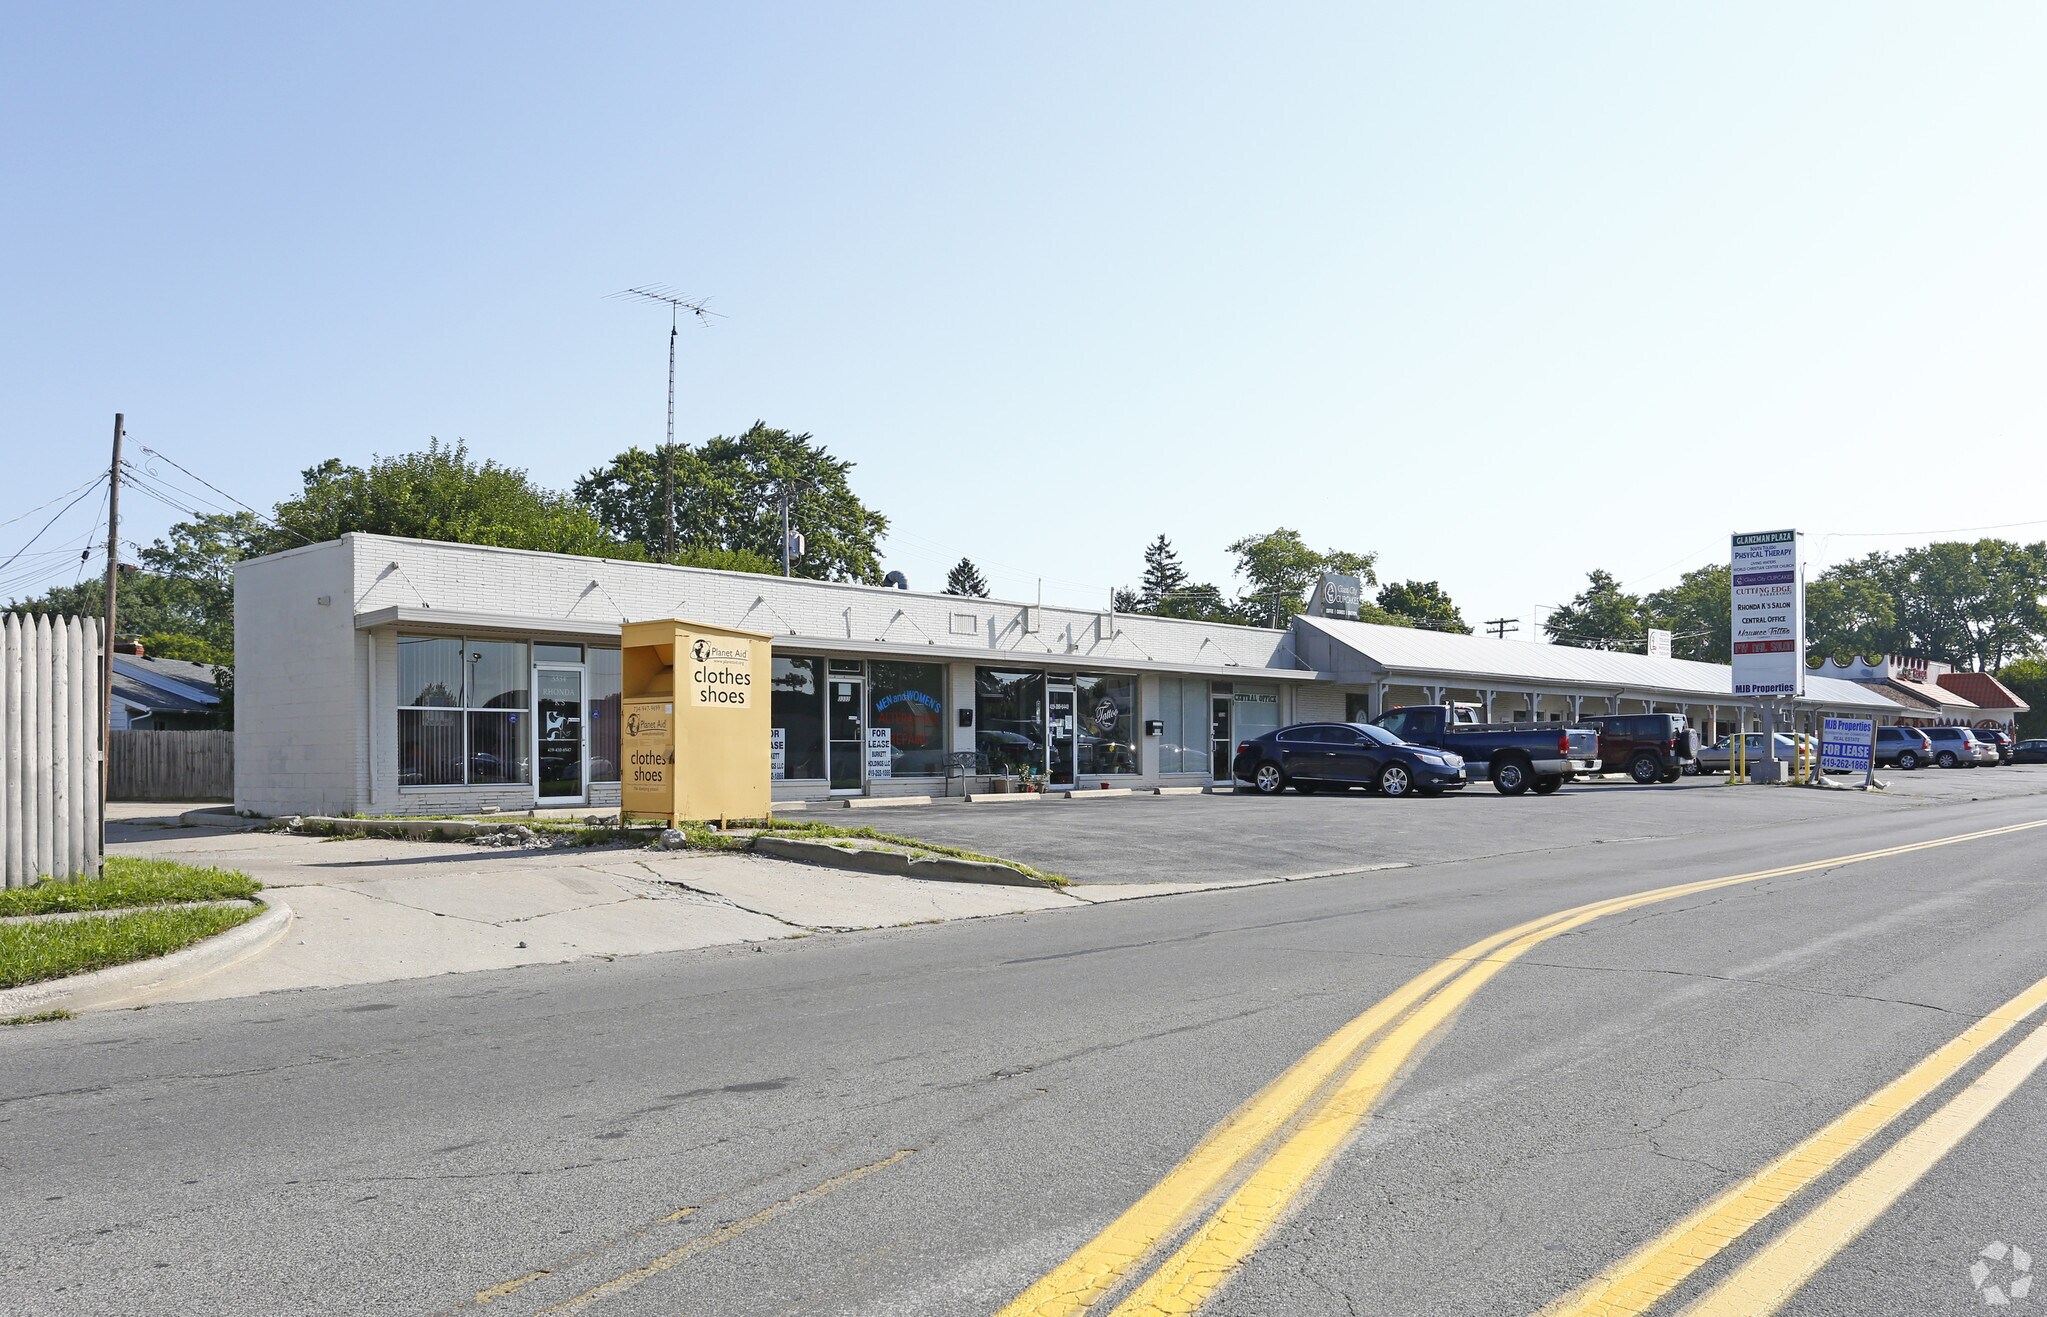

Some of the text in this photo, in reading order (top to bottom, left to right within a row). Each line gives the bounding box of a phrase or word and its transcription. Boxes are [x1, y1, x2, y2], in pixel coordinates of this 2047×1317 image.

[1736, 532, 1792, 545] GLANZMAN PLAZA
[1764, 548, 1792, 557] THERAPY
[1736, 587, 1770, 595] CUTTING
[1738, 603, 1760, 611] RHONDA
[711, 647, 747, 658] Planet Aid
[694, 666, 751, 686] clothes
[543, 688, 575, 696] RHONDA
[1735, 683, 1794, 693] MJB Properties
[700, 685, 745, 704] shoes
[1234, 694, 1277, 703] CENTRAL OFFICE
[875, 694, 893, 713] MEN
[893, 693, 907, 703] and
[640, 720, 667, 729] Planet Aid
[1825, 719, 1872, 732] MJB Properties
[872, 729, 886, 738] FOR
[868, 740, 890, 748] LEASE
[1823, 743, 1869, 758] FOR LEASE
[631, 750, 667, 765] clothes
[1822, 758, 1868, 770] 419-262-1866
[634, 766, 662, 782] shoes
